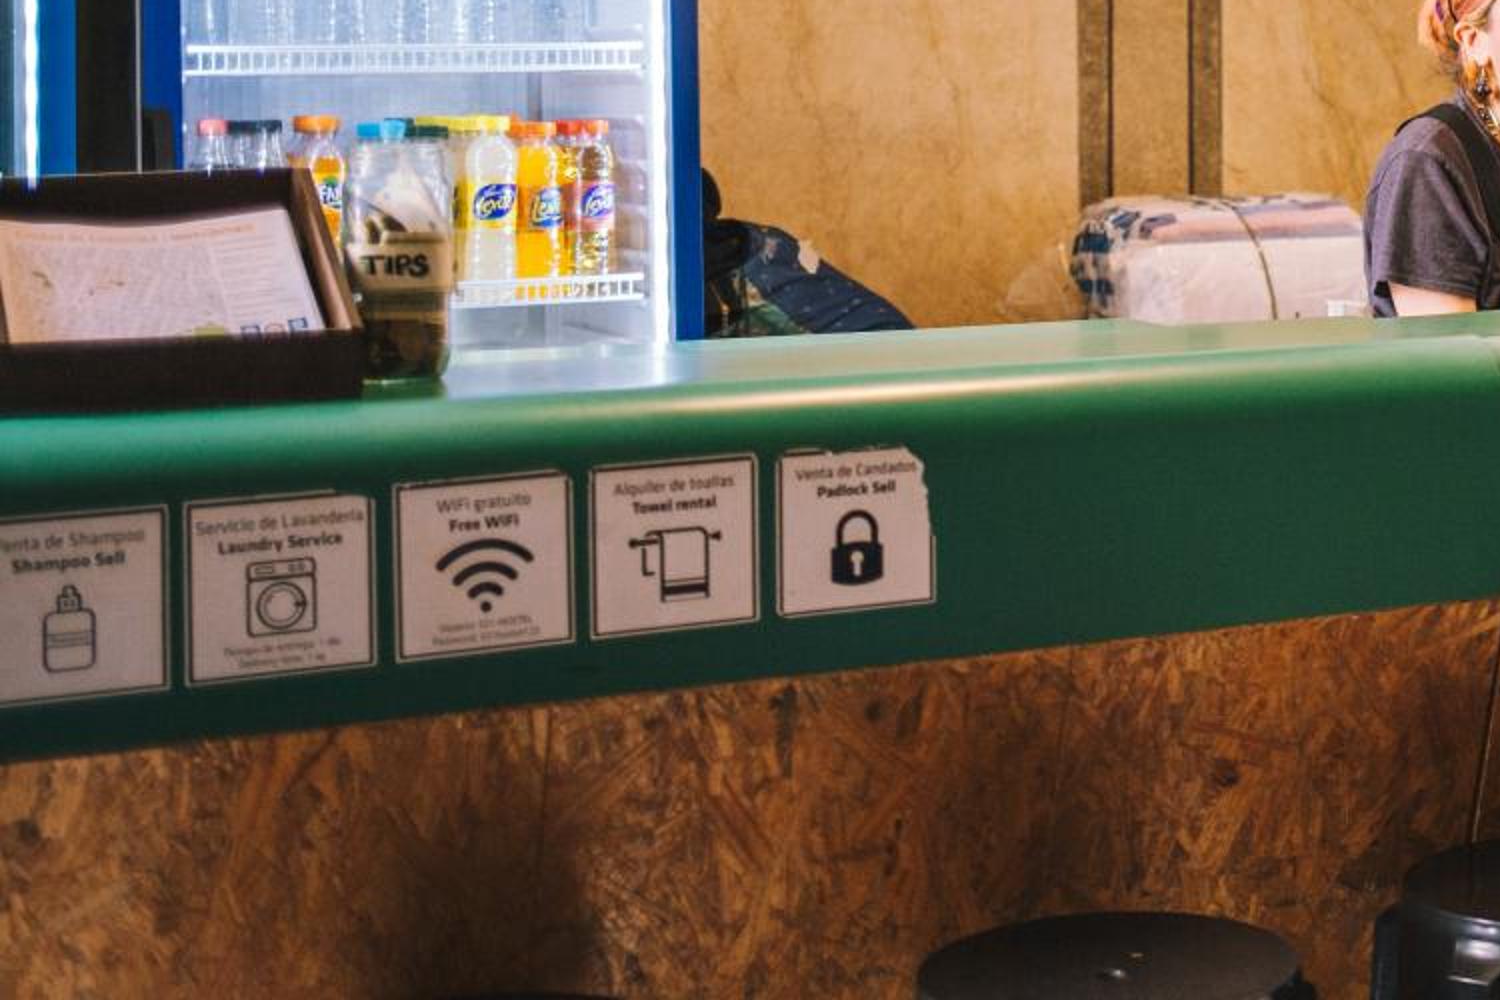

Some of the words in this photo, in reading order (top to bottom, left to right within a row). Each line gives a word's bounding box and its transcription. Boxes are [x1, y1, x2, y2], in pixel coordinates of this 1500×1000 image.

[361, 254, 430, 278] TIPS
[795, 467, 834, 481] Venta
[837, 466, 852, 478] de
[854, 461, 918, 476] Candados
[614, 482, 667, 498] Alquiler
[670, 479, 686, 491] de
[689, 474, 734, 490] toallas
[817, 484, 869, 499] Padlock
[872, 480, 896, 494] Sell
[436, 497, 470, 514] WiFi
[473, 493, 532, 513] gratuito
[632, 500, 673, 515] Towel
[675, 496, 717, 511] rental
[195, 520, 256, 536] Servicio
[259, 517, 277, 530] de
[449, 519, 481, 532] Free
[484, 513, 520, 529] WiFi
[44, 535, 64, 549] de
[68, 529, 145, 547] Shampoo
[218, 537, 283, 555] Laundry
[286, 530, 342, 548] Service
[11, 556, 91, 573] Shampoo
[94, 550, 126, 566] Sell
